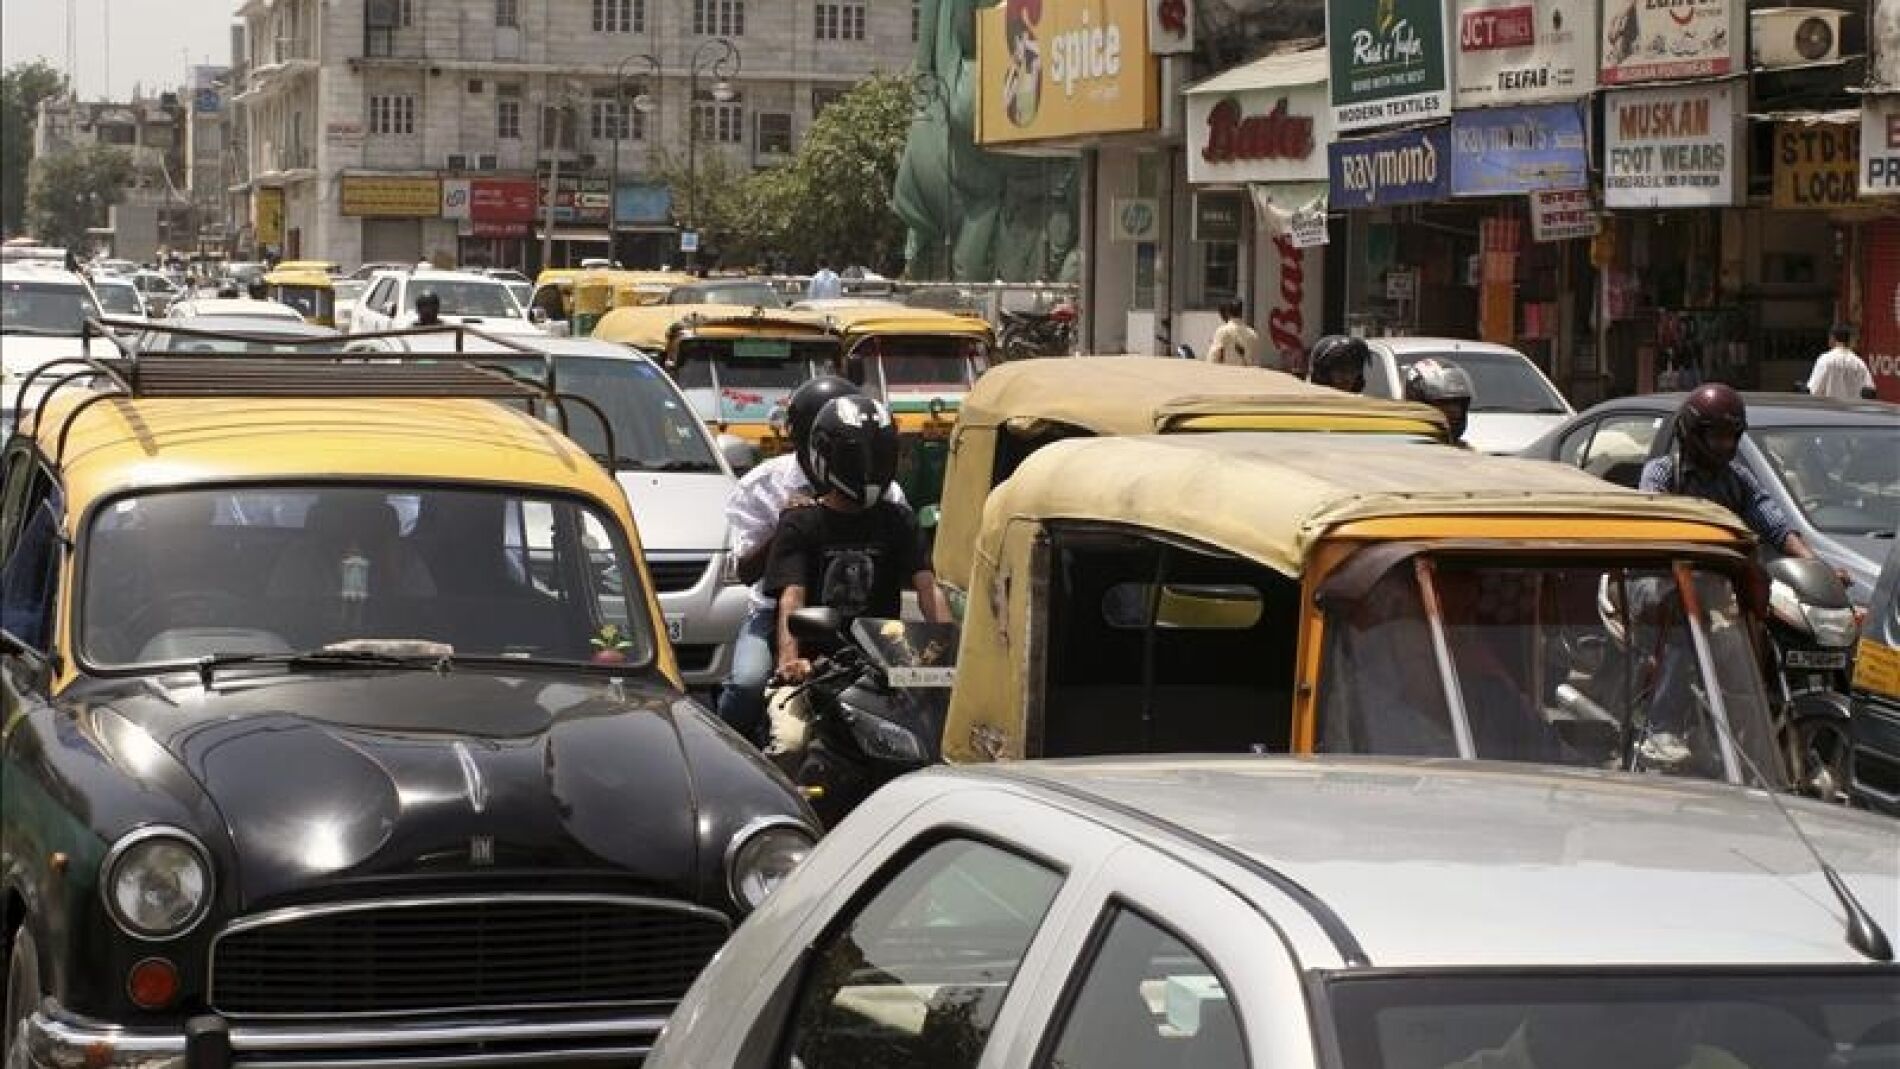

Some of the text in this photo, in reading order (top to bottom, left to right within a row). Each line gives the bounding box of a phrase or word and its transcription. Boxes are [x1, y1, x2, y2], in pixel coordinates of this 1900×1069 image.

[1463, 16, 1497, 46] JCT
[1051, 9, 1121, 96] spice
[1499, 68, 1548, 91] TEXFAB
[1339, 95, 1440, 122] MODERN TEXTILES
[1619, 100, 1711, 140] MUSKAN
[1202, 98, 1315, 163] Bata
[1610, 142, 1726, 175] FOOT WEARS
